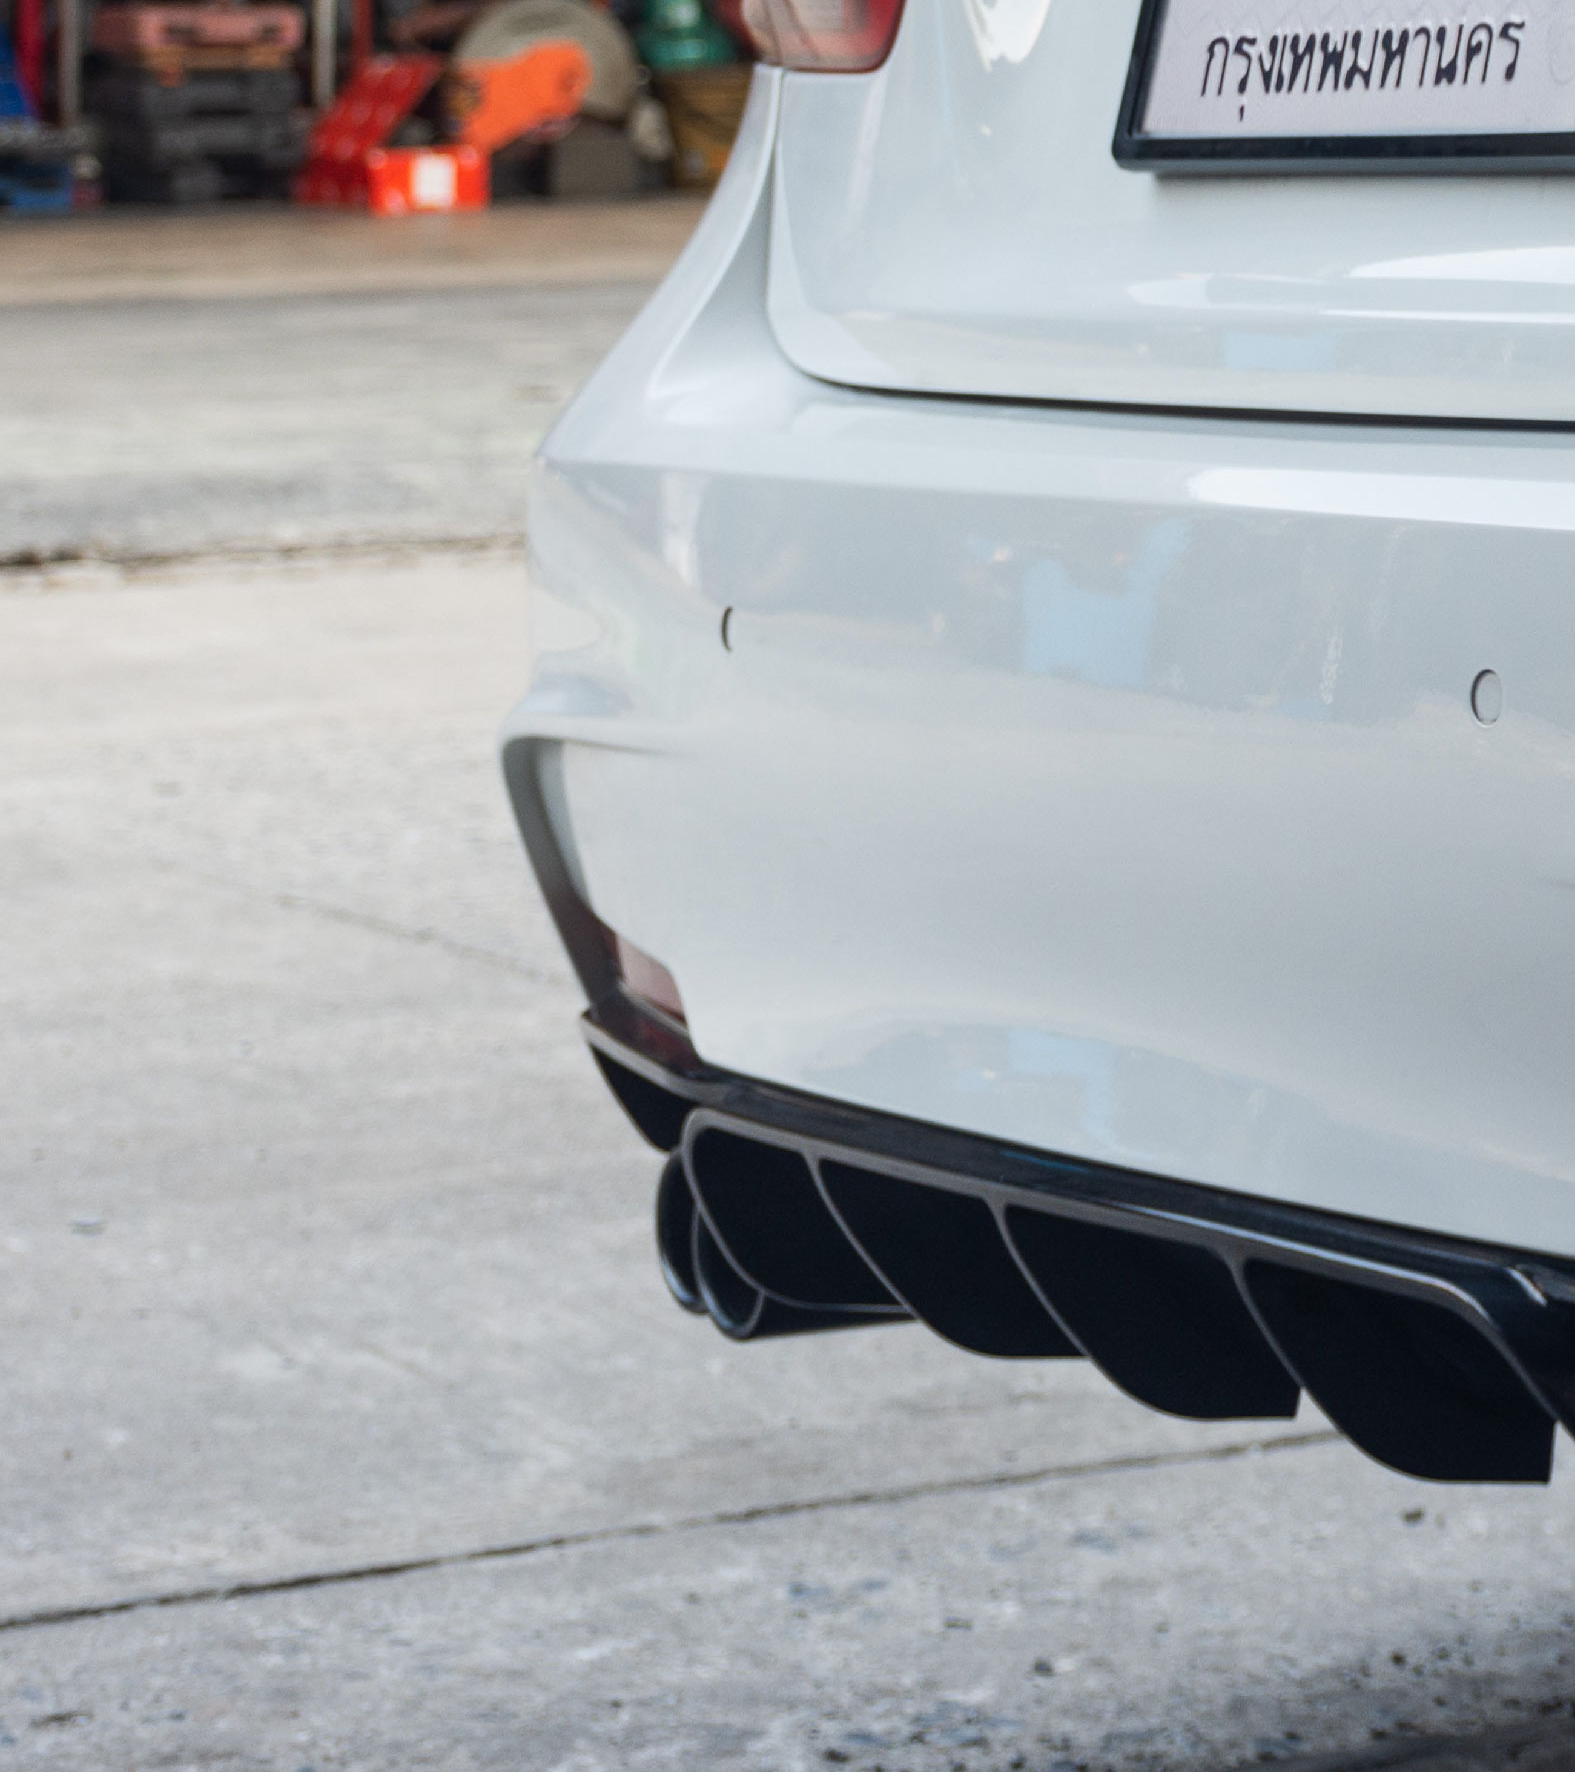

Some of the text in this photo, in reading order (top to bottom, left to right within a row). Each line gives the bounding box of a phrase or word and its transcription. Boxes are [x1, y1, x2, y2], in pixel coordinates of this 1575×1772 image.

[1200, 21, 1526, 123] กรุงเทพมหานคร
